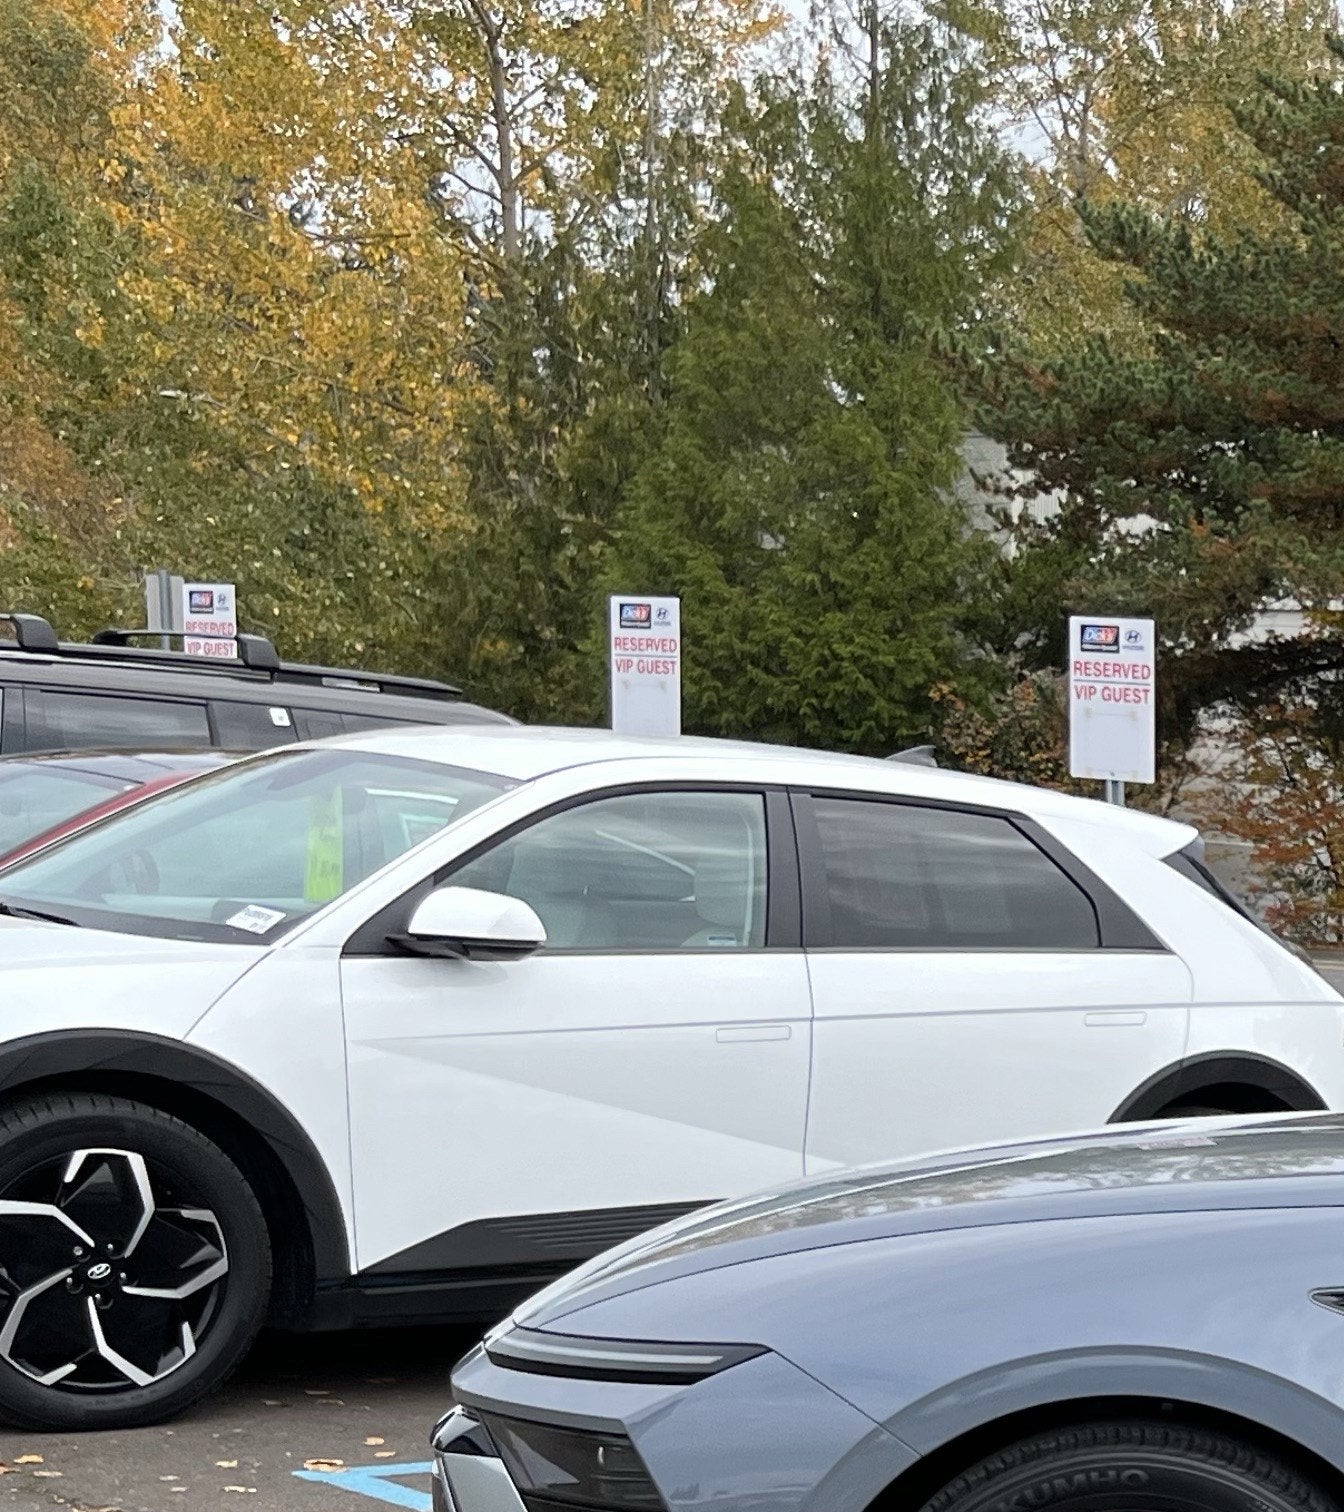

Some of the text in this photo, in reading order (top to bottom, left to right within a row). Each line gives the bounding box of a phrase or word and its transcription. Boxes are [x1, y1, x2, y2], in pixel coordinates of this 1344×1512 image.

[614, 637, 677, 652] RESERVED
[616, 659, 677, 675] VIP GUEST
[1074, 661, 1151, 680] RESERVED
[1075, 685, 1150, 704] VIP GUEST
